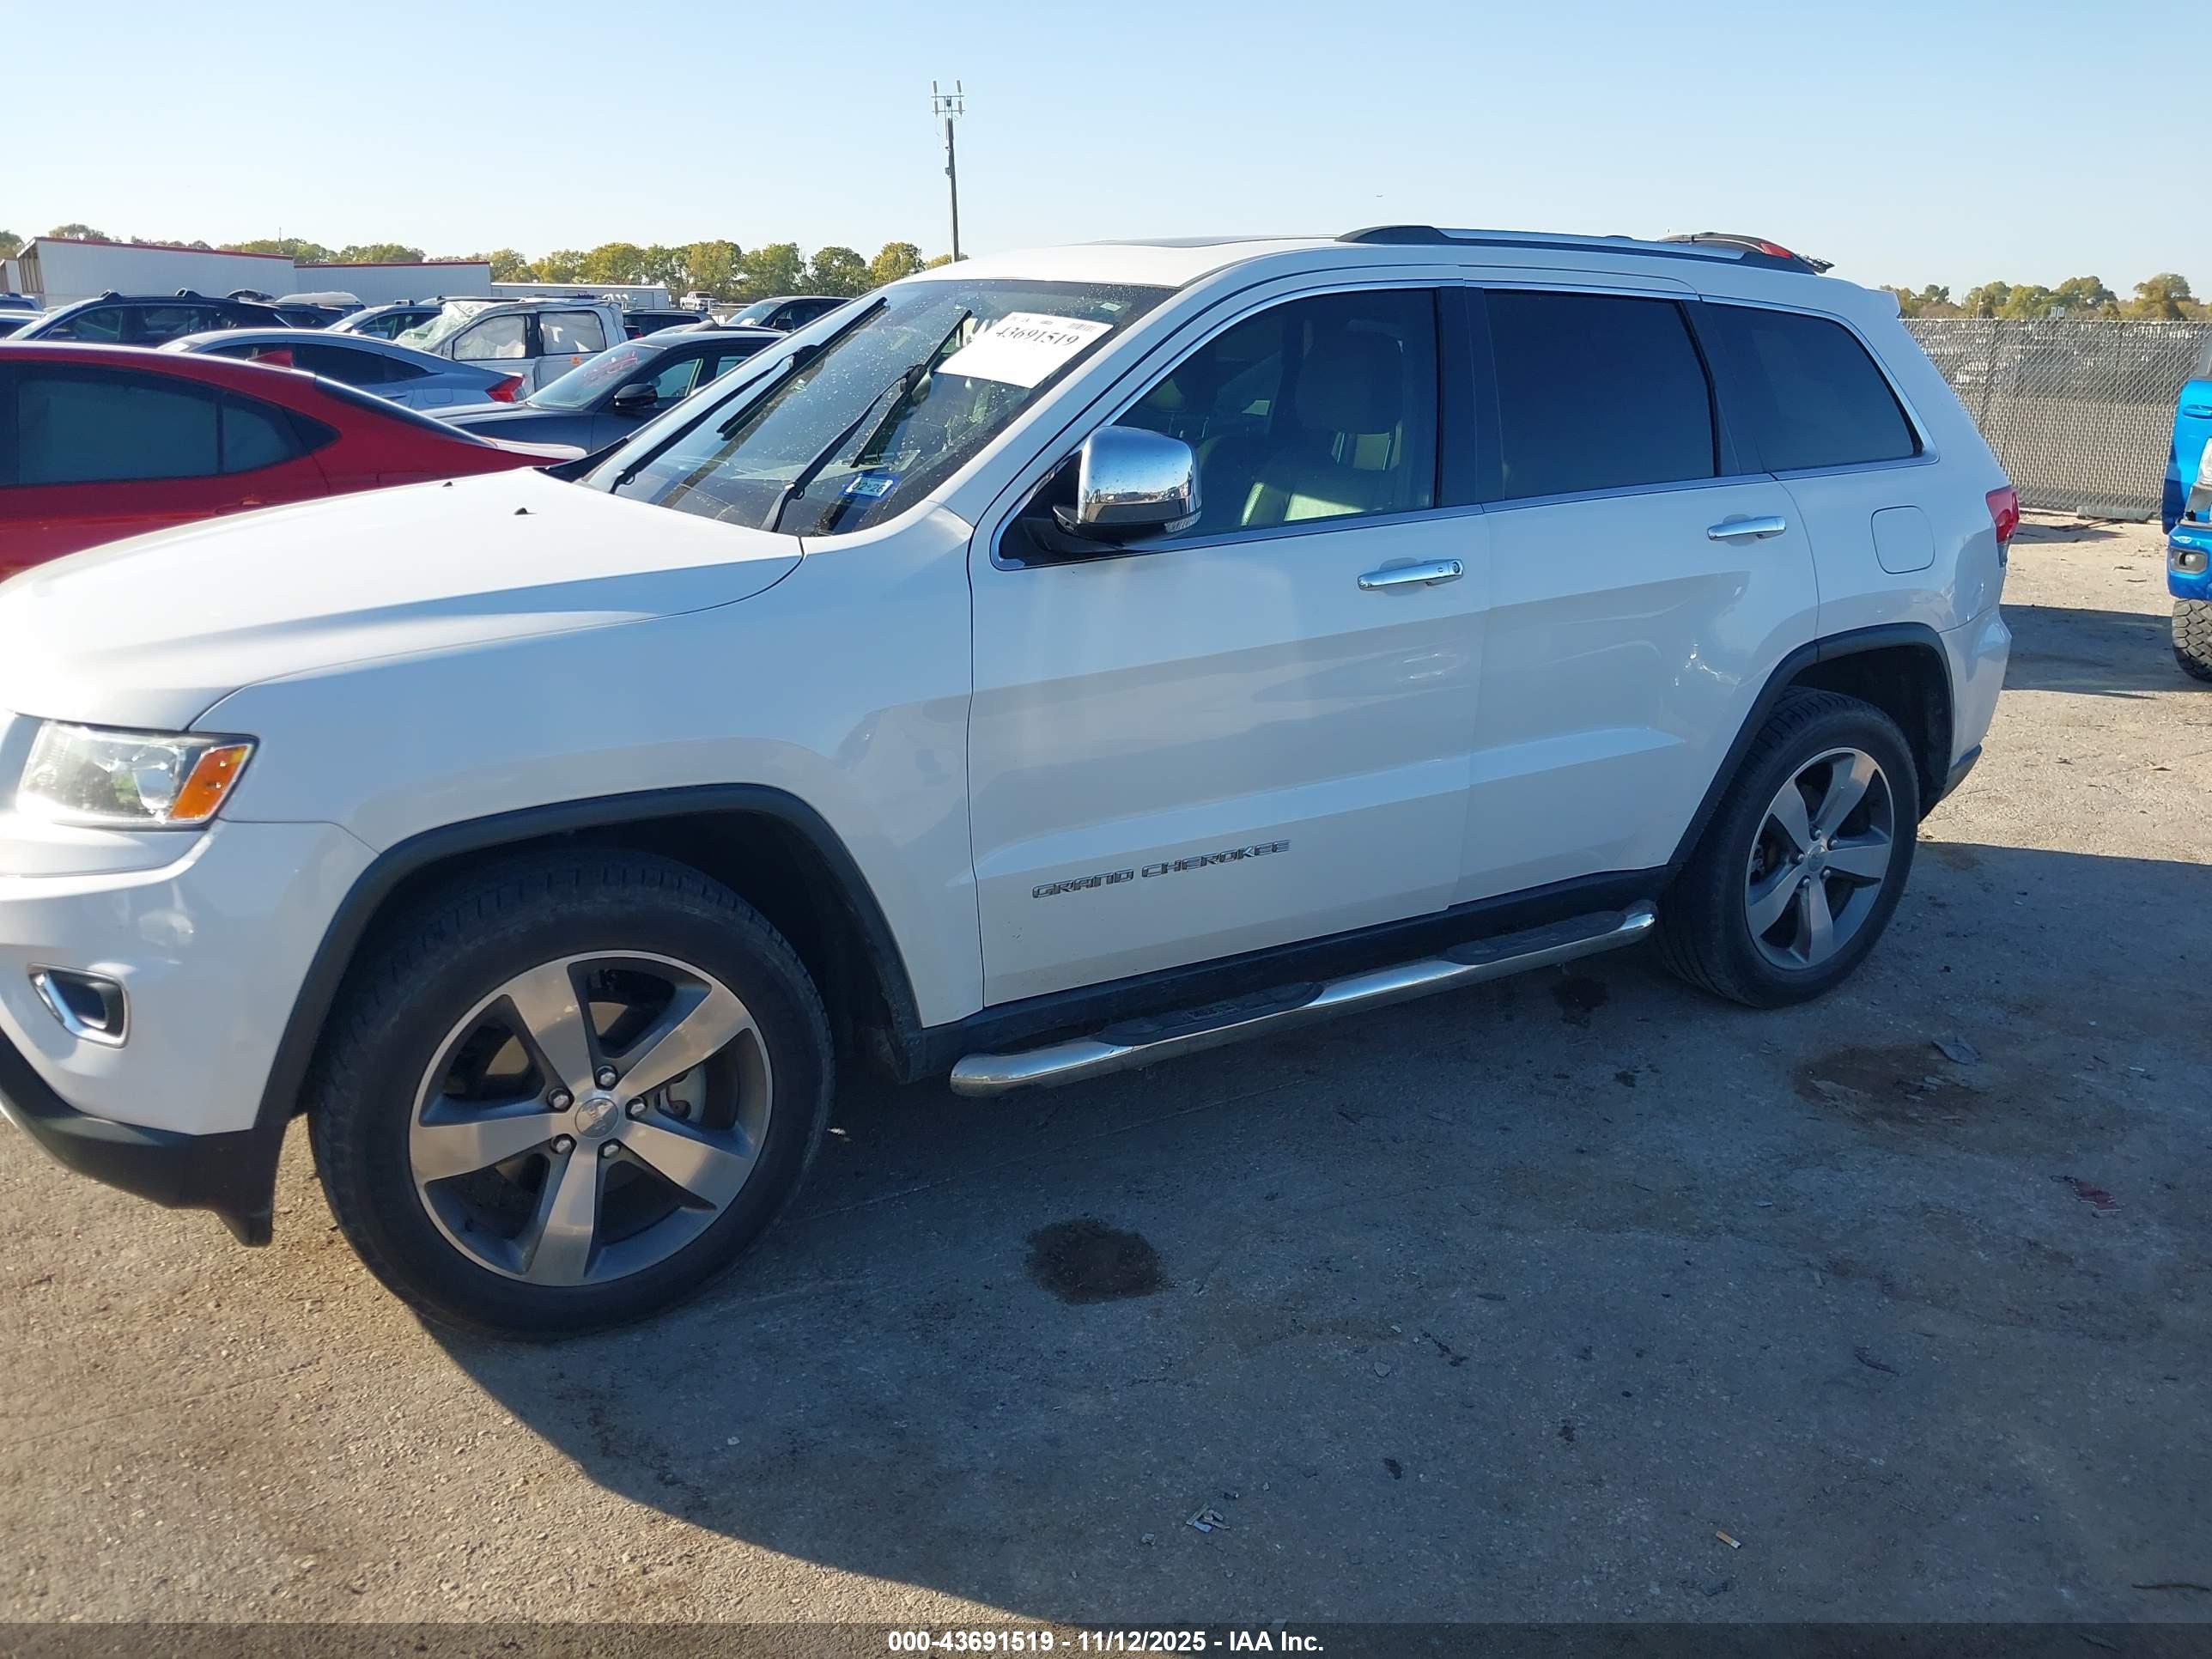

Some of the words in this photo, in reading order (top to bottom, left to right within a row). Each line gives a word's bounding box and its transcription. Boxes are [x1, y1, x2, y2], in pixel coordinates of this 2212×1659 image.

[995, 325, 1079, 345] 43691519
[1032, 868, 1134, 898] GRAND
[1141, 839, 1291, 878] CHEROKEE
